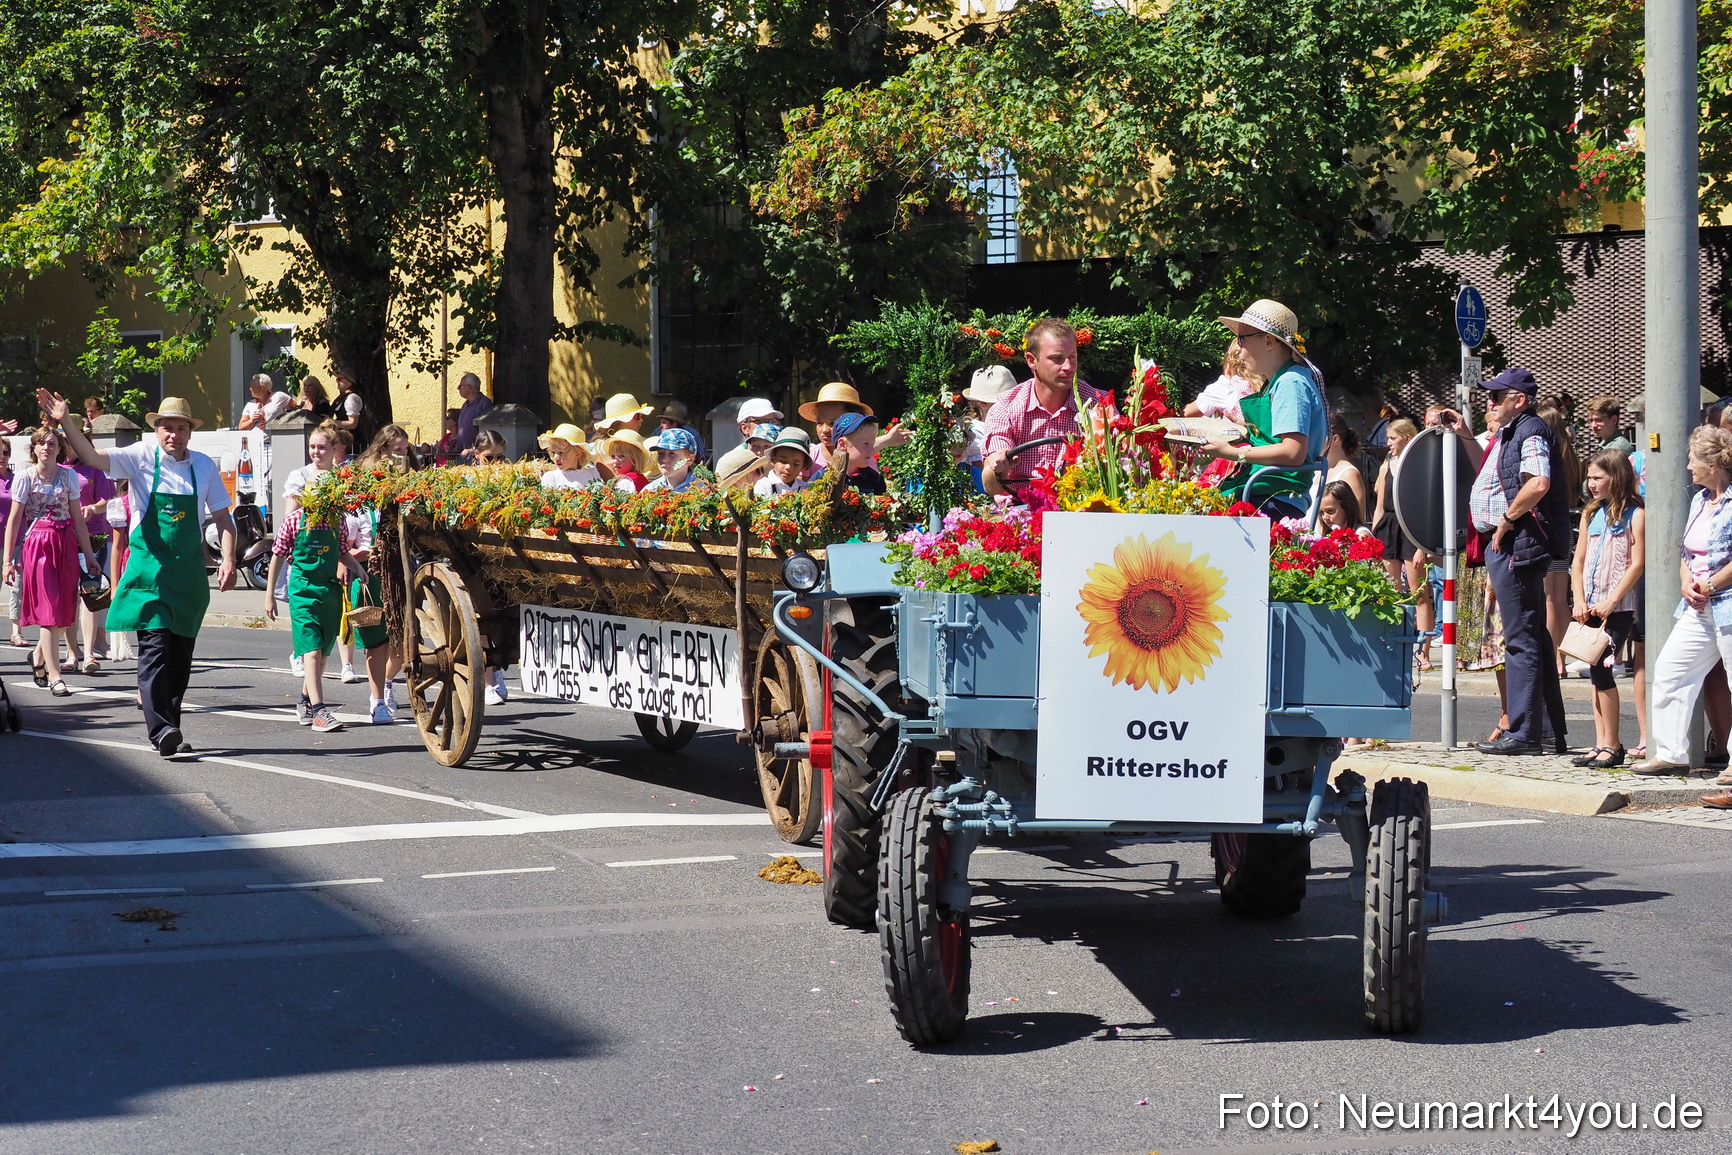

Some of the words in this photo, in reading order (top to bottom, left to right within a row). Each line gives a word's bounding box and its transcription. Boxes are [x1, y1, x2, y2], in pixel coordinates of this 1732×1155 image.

[523, 608, 627, 677] RITTERSHOF
[530, 670, 549, 693] um
[552, 668, 581, 701] 1955
[608, 678, 633, 710] des
[639, 675, 678, 719] taugt
[682, 683, 713, 724] ma!
[1126, 720, 1189, 741] OGV
[1086, 756, 1228, 779] Rittershof
